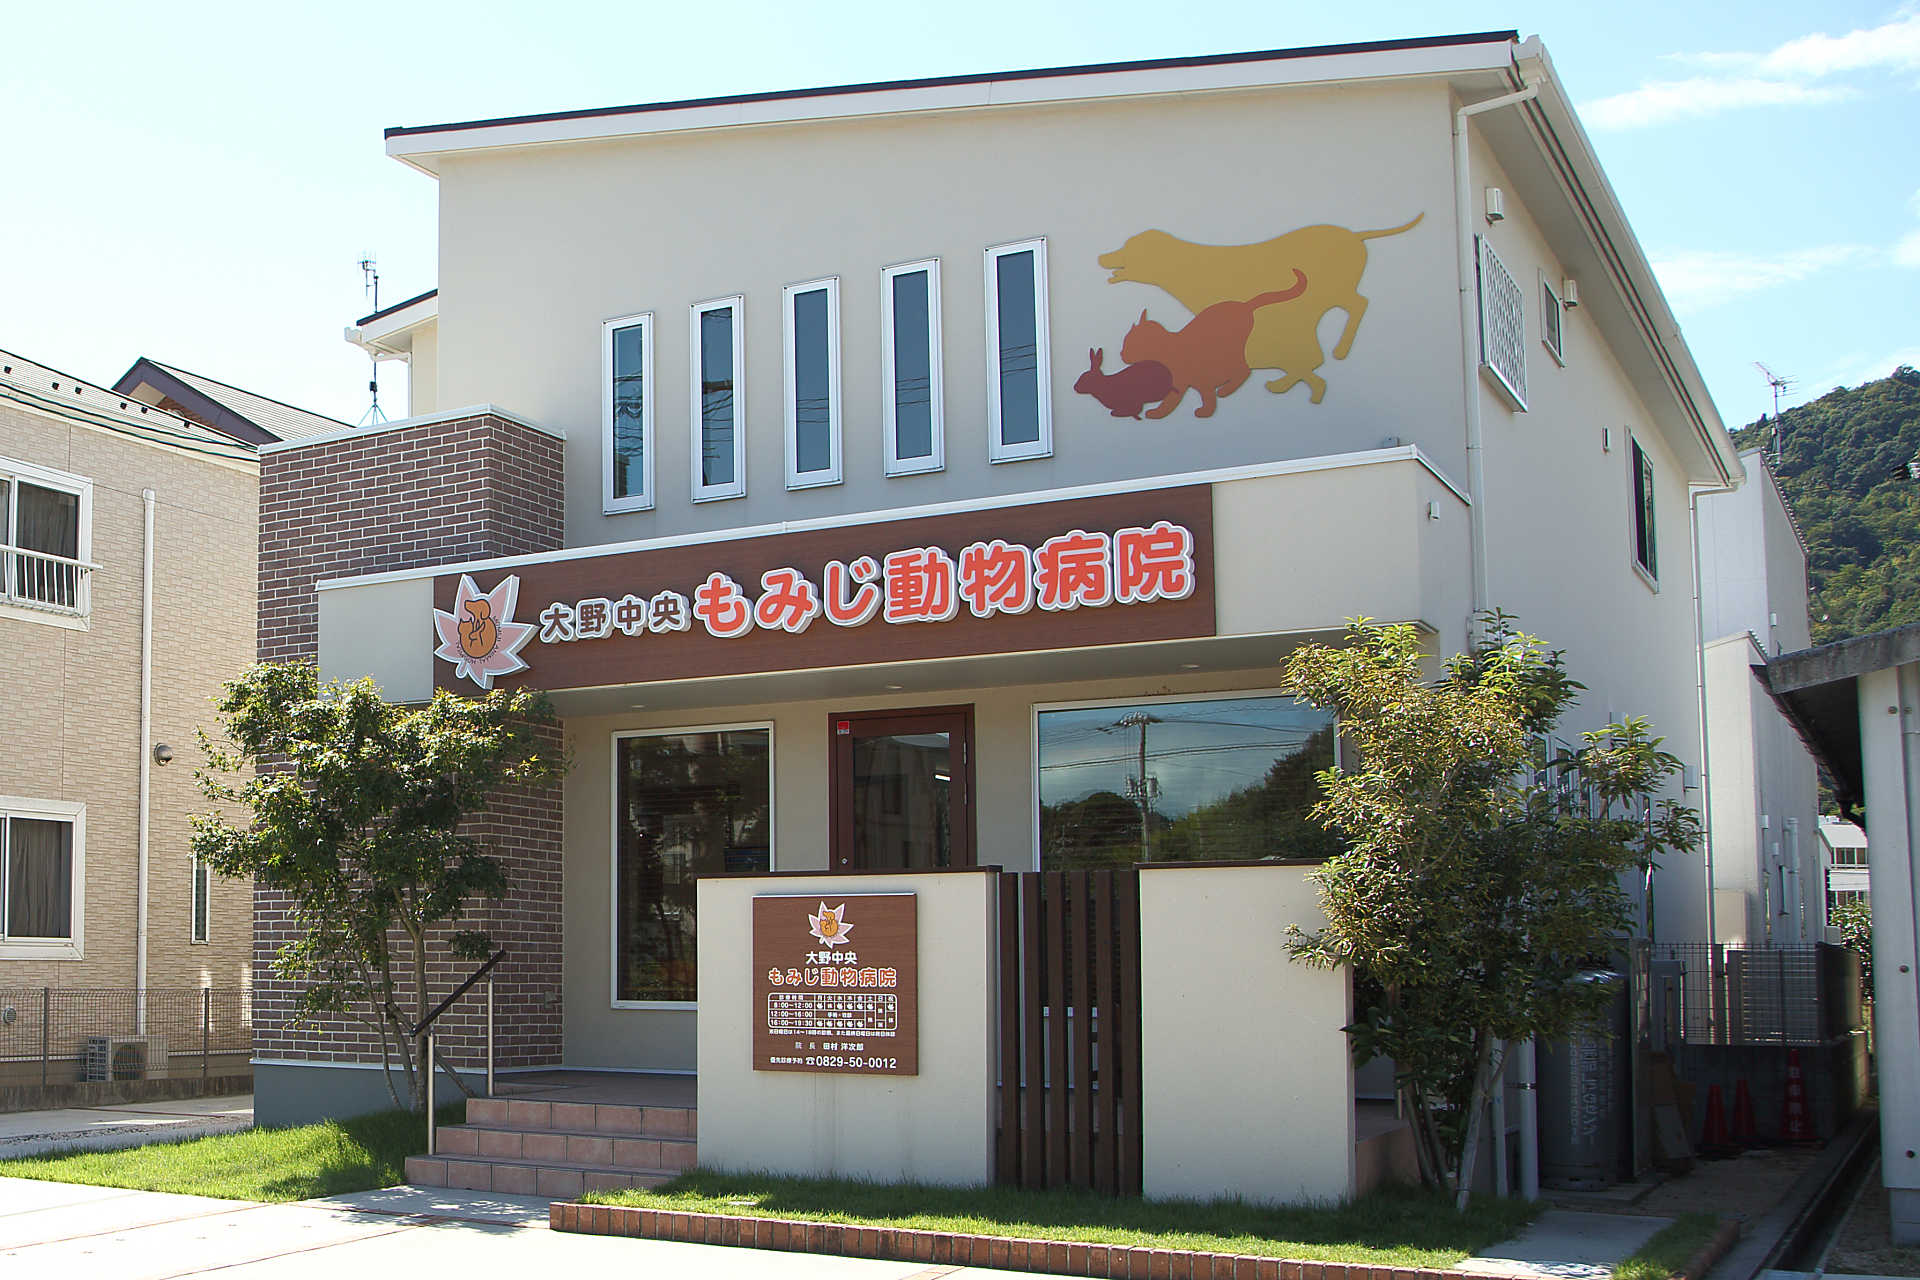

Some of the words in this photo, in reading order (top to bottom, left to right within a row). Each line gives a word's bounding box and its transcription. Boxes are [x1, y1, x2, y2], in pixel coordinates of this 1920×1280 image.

[541, 591, 691, 643] 大野中央
[694, 521, 1195, 638] もみじ動物病院
[805, 951, 858, 965] 大野中央
[768, 967, 897, 987] もみじ動物病院
[816, 1056, 897, 1069] 0829-50-0012
